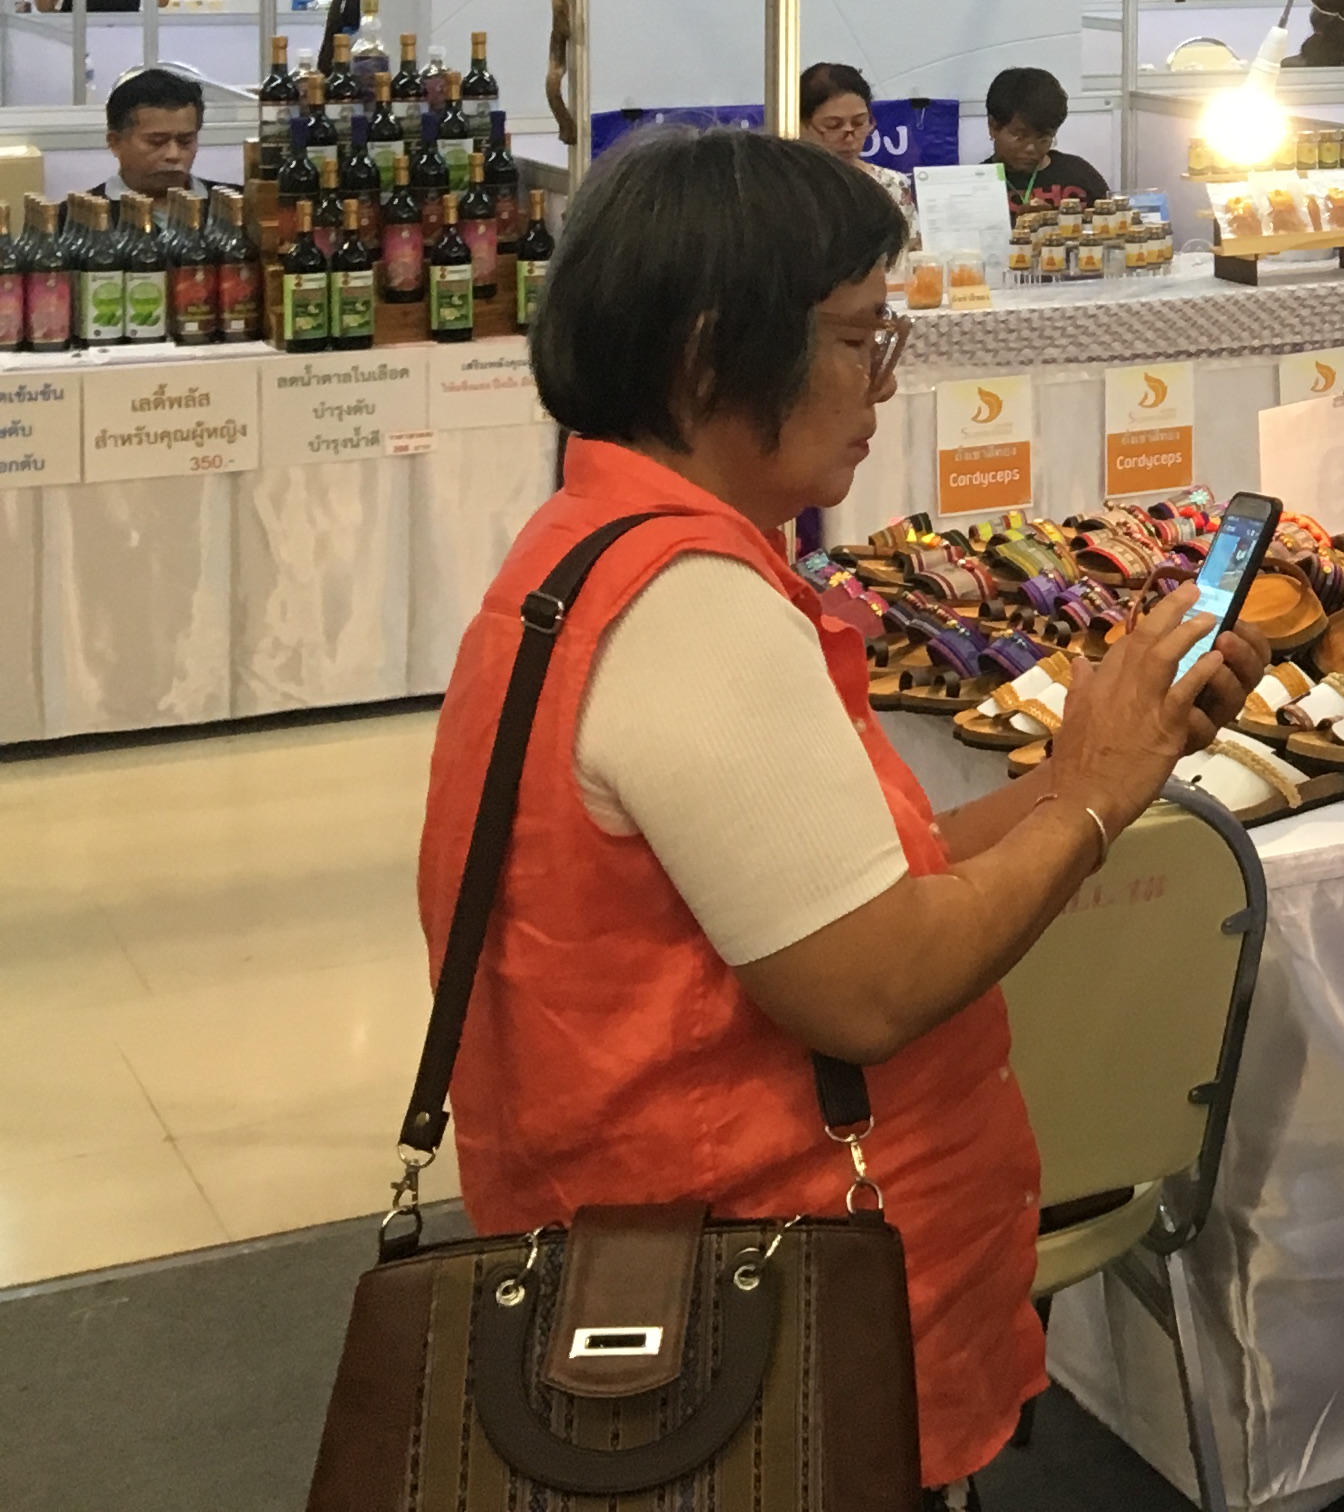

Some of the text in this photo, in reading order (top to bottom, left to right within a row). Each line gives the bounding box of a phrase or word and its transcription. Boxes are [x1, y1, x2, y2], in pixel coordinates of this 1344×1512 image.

[277, 363, 409, 389] ลดน้ำตาลในเลือด
[131, 384, 210, 413] เลดี้พลัส
[95, 418, 247, 449] สำหรับคุณผู้หญิง
[1116, 451, 1182, 471] Cordyceps
[949, 468, 1020, 489] Cordyceps
